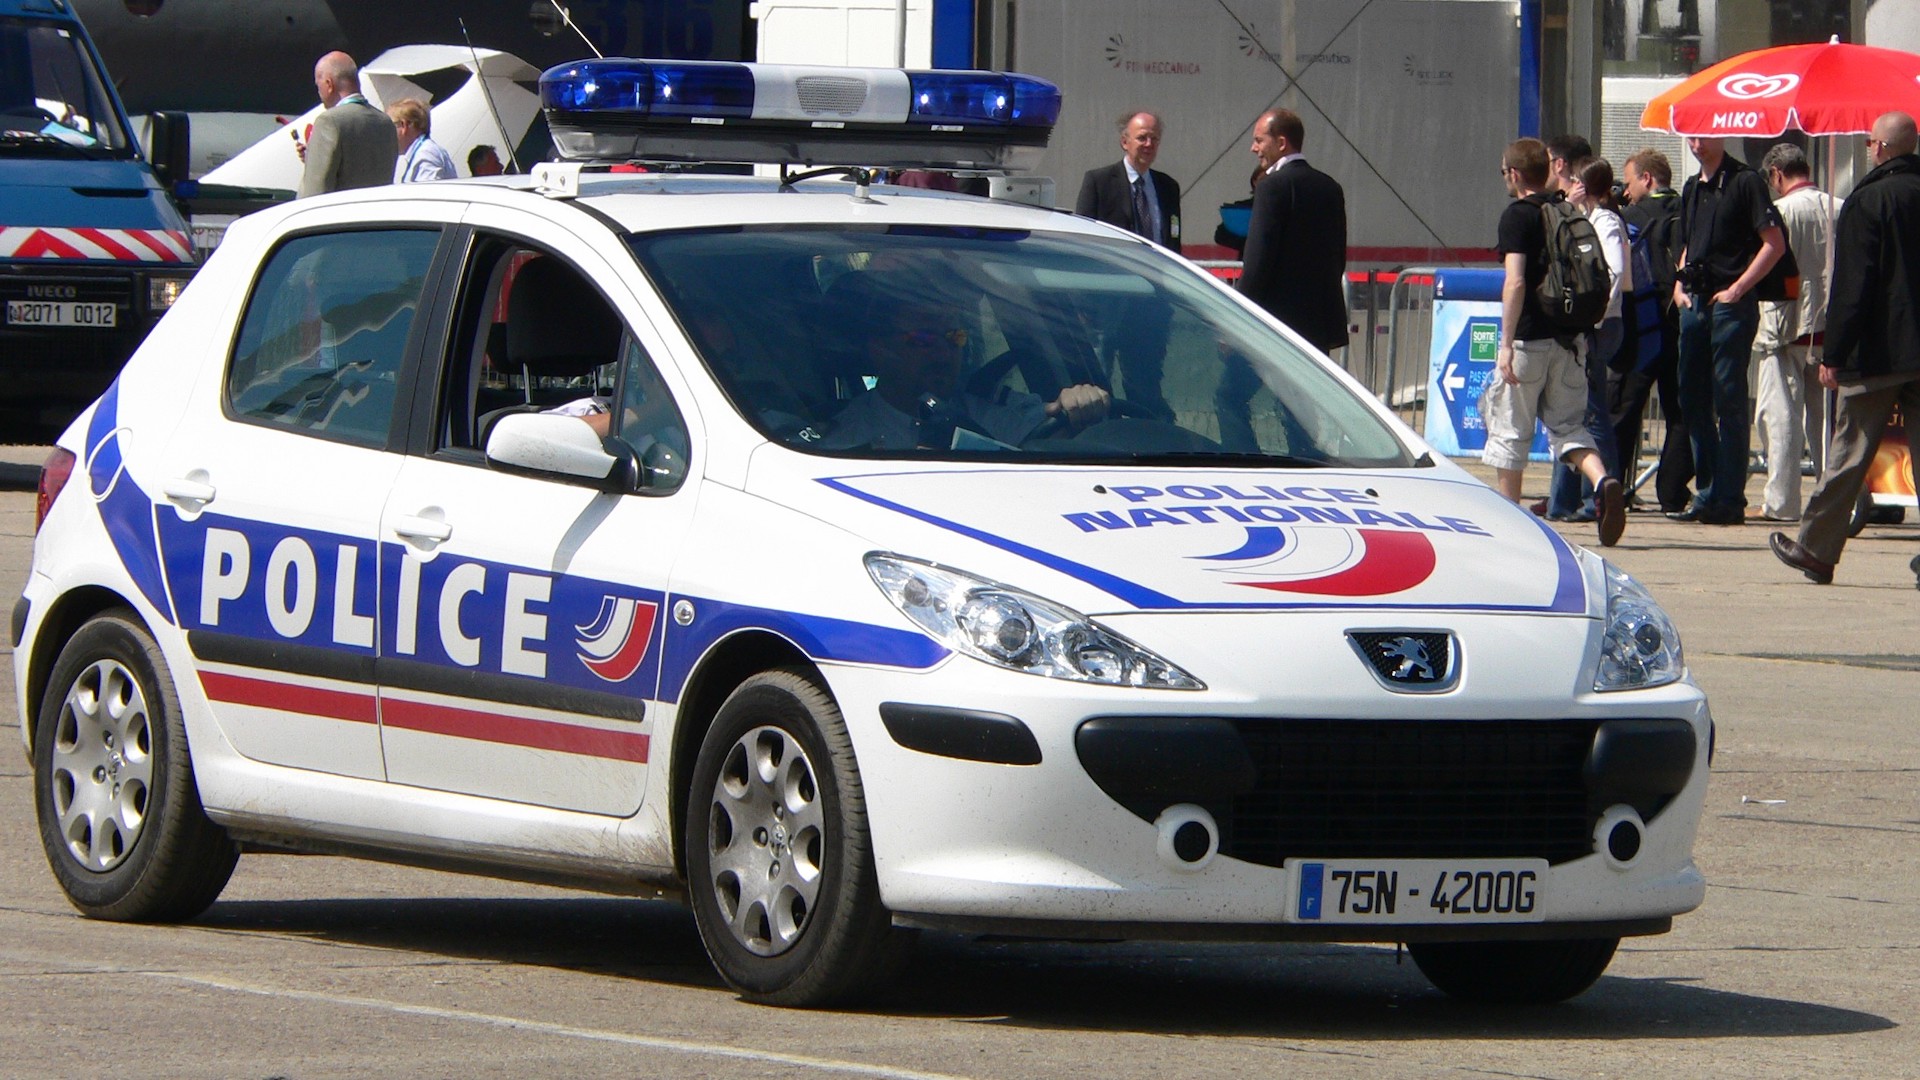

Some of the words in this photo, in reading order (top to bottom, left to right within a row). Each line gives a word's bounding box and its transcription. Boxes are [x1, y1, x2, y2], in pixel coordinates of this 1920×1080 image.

[1712, 112, 1758, 129] MIKO
[27, 285, 76, 298] IVECO
[74, 307, 113, 324] 0012
[1107, 484, 1381, 506] POLICE
[1061, 505, 1495, 538] NATIONALE
[199, 526, 553, 679] POLICE
[1331, 870, 1398, 914] 75N
[1430, 870, 1537, 914] 4200G
[1306, 897, 1315, 911] F
